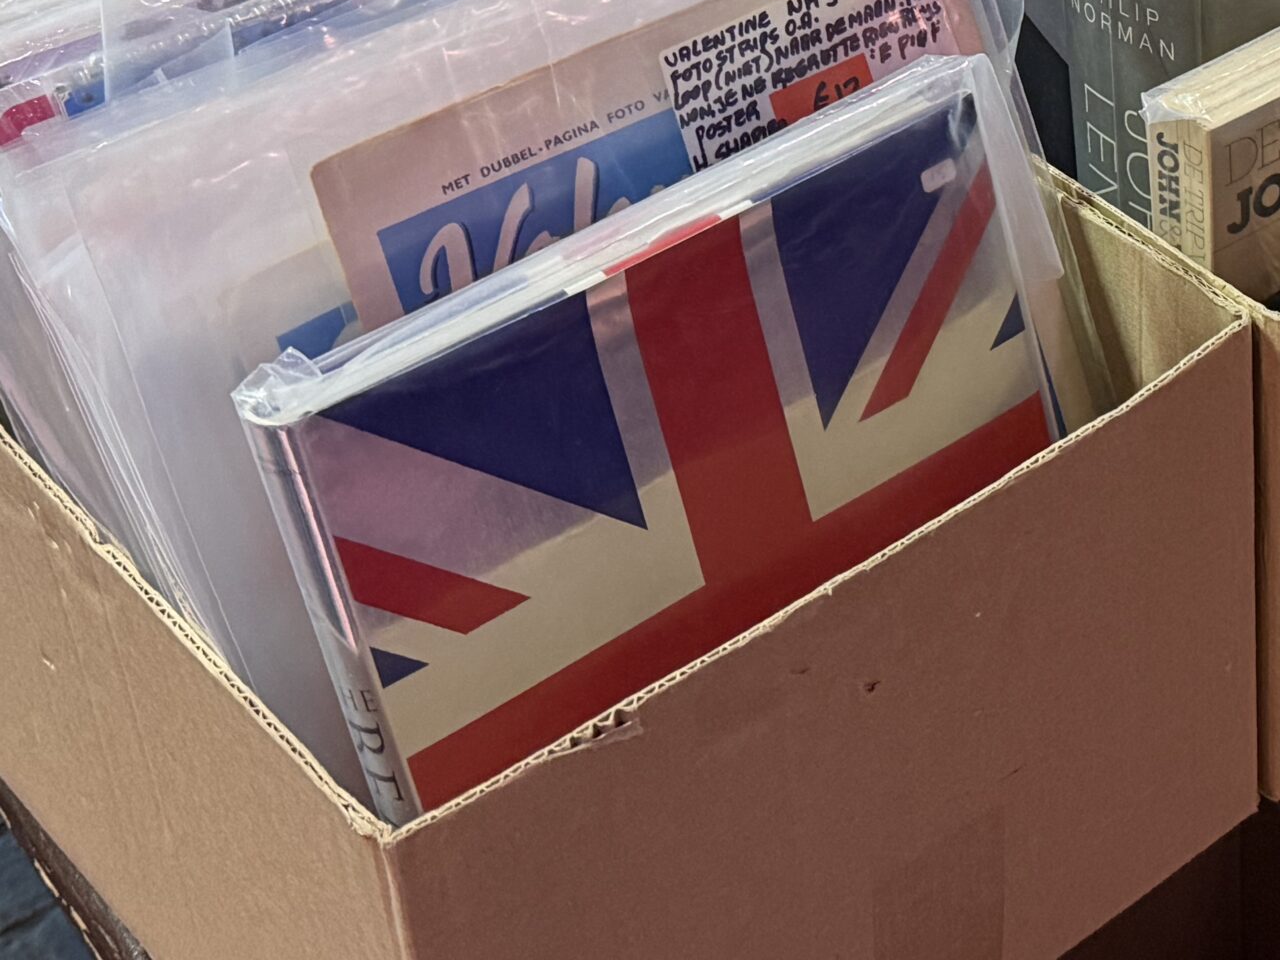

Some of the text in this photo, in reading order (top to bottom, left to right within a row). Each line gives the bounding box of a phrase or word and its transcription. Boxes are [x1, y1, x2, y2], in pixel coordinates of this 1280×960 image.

[664, 10, 771, 68] VALENTINE
[441, 172, 472, 196] MET
[606, 98, 646, 125] FOTO
[695, 99, 761, 141] POSTER
[1156, 132, 1181, 227] JOHN
